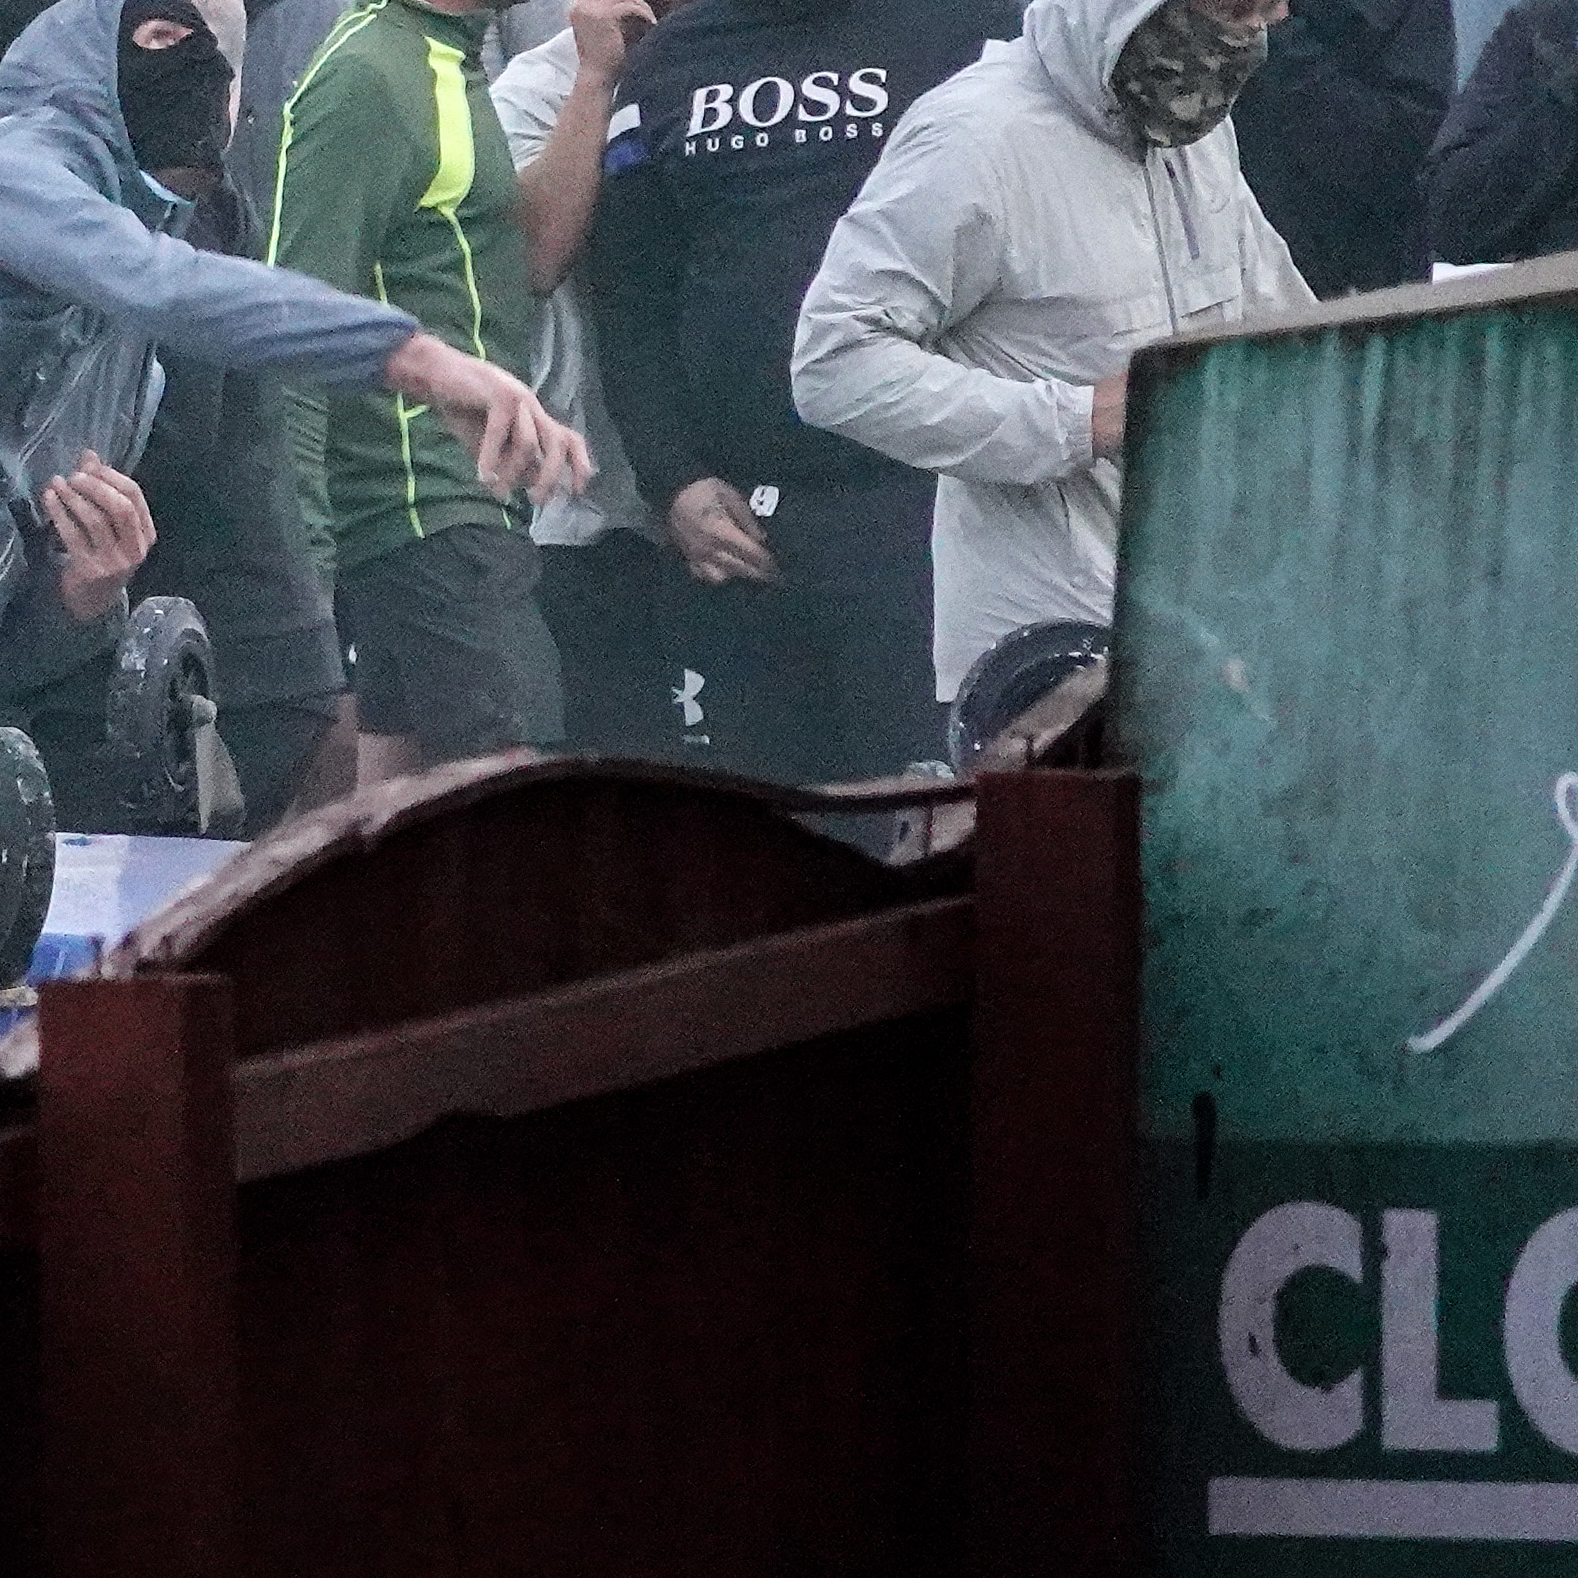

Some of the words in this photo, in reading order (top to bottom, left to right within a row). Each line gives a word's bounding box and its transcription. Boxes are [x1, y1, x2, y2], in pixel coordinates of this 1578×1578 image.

[686, 67, 889, 138] BOSS
[684, 132, 770, 157] HUGO
[794, 121, 885, 144] BOSS
